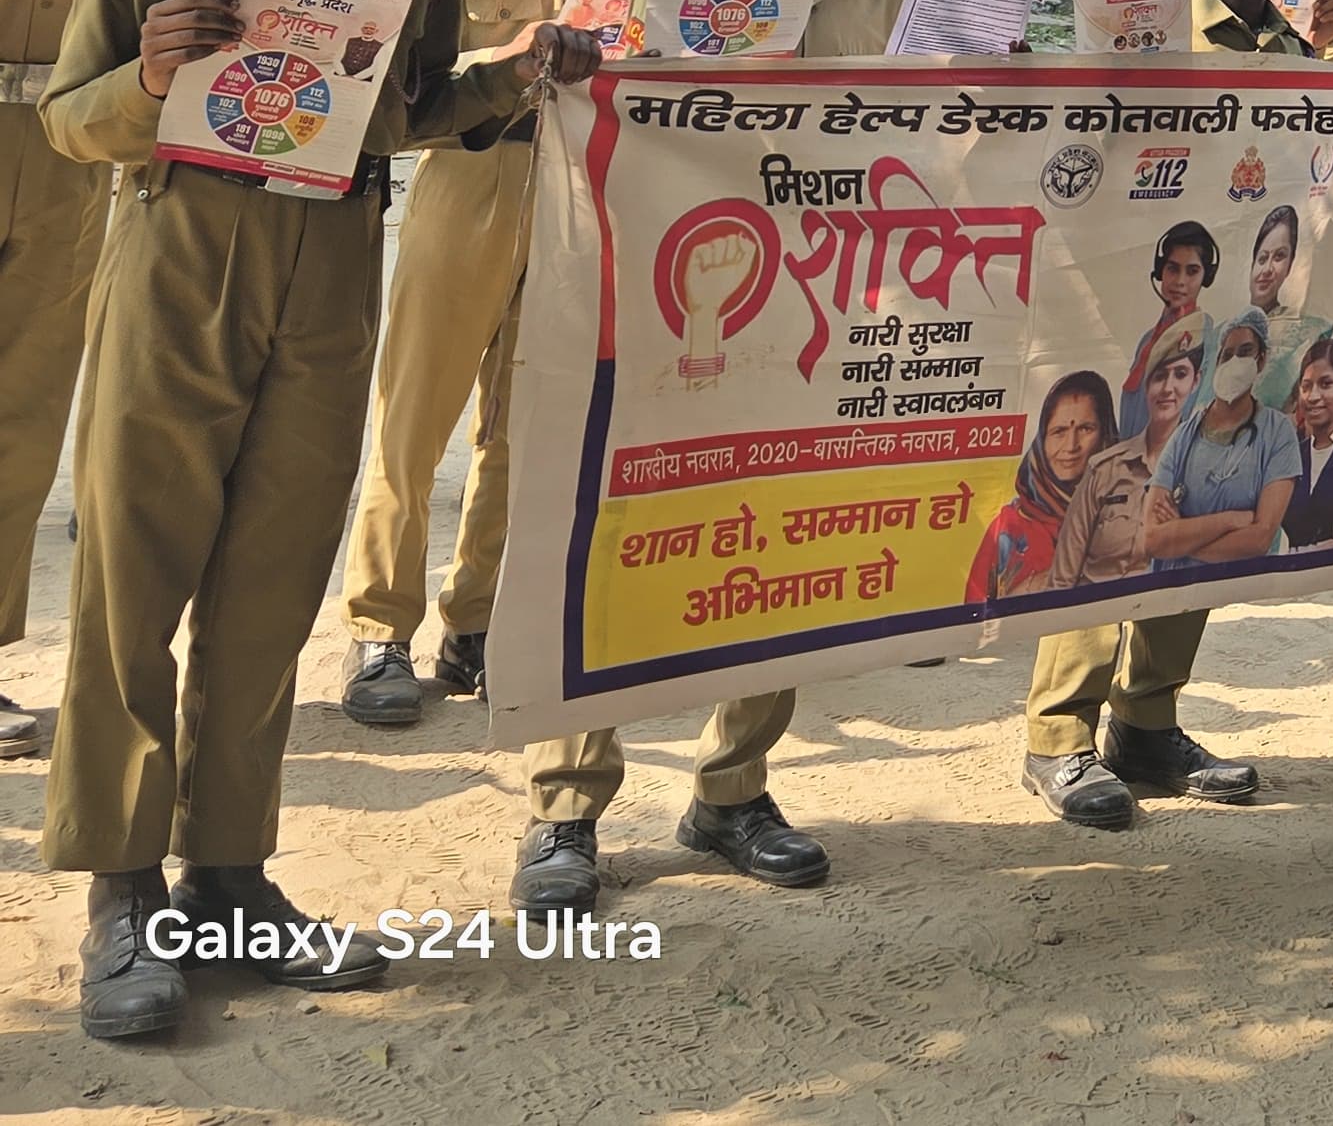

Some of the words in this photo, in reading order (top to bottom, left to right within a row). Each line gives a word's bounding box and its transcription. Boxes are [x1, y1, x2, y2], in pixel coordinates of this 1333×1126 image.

[716, 8, 746, 21] 1076
[257, 55, 281, 68] 1930
[219, 97, 236, 109] 102
[254, 87, 291, 108] 1076
[309, 87, 325, 99] 112
[625, 89, 811, 132] महिला
[819, 92, 930, 135] हेल्प
[936, 92, 1053, 135] डेस्क
[1064, 93, 1242, 134] कोतवाली
[759, 153, 865, 206] मिशन
[1152, 158, 1188, 188] 112
[784, 155, 1047, 385] शक्ति
[849, 315, 902, 347] नारी
[908, 320, 973, 356] सुरक्षा
[842, 352, 895, 383] नारी
[900, 356, 984, 382] सम्मान
[837, 386, 888, 419] नारी
[893, 383, 1006, 417] स्वावलंबन
[621, 447, 680, 484] शारदीय
[685, 445, 741, 474] नवरात्र,
[902, 427, 959, 458] नवरात्र,
[968, 426, 1014, 448] 2021
[620, 522, 704, 568] शान
[711, 503, 768, 558] हो,
[782, 497, 921, 545] सम्मान
[929, 481, 974, 530] हो
[683, 566, 847, 626] अभिमान
[857, 548, 899, 599] हो
